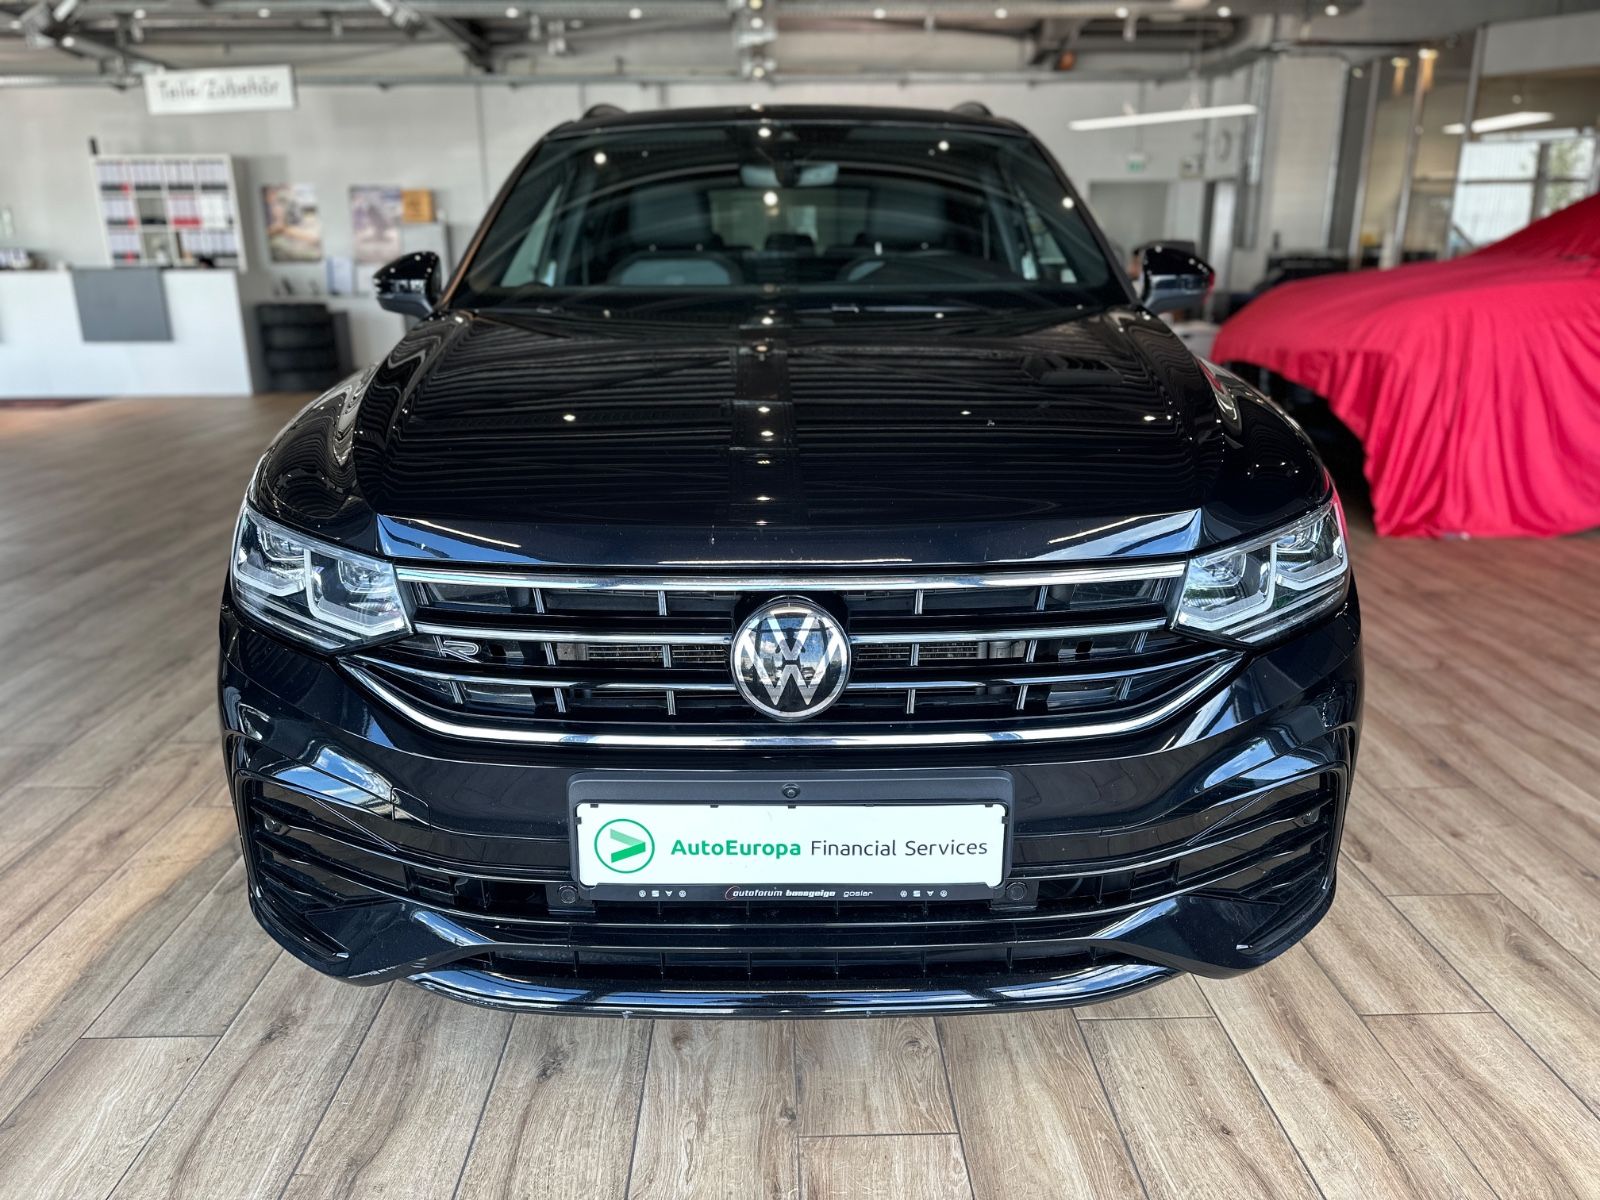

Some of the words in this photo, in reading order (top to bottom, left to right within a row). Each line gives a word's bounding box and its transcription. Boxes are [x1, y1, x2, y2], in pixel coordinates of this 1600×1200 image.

[671, 839, 801, 859] AutoEuropa
[811, 840, 896, 856] Financial
[905, 839, 988, 856] Services
